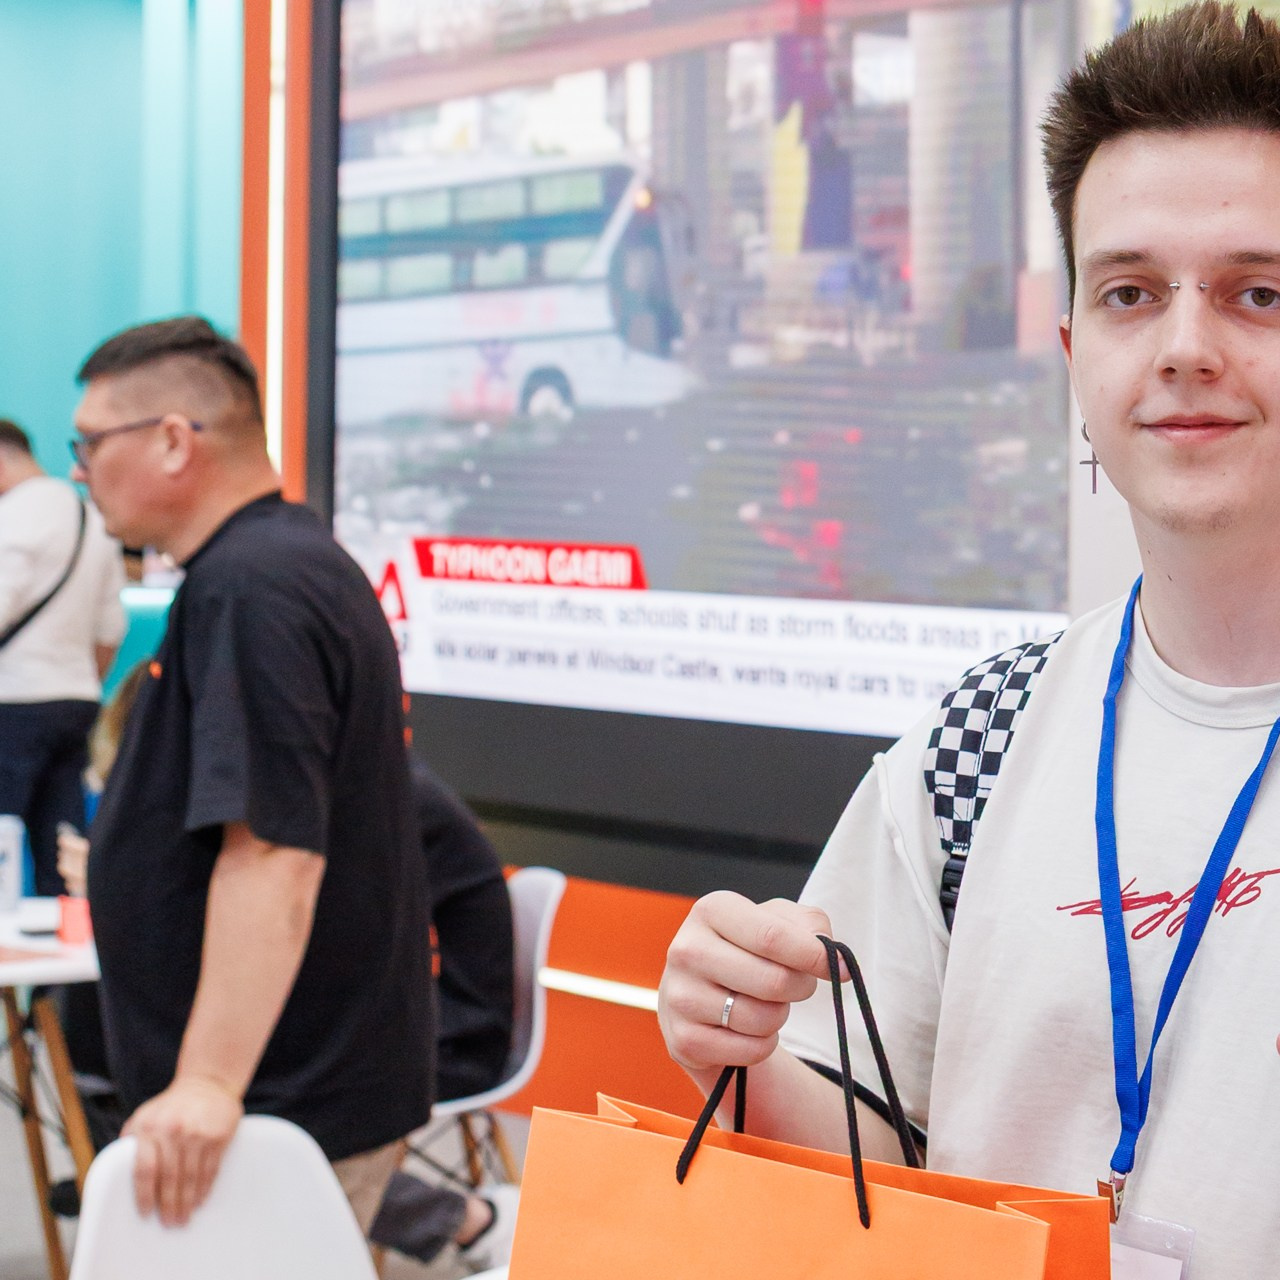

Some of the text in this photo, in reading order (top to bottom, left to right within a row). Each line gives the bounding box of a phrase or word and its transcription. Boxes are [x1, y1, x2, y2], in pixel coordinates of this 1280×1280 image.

[429, 542, 548, 582] TYPHOON
[433, 589, 540, 620] Government
[617, 602, 689, 629] schools
[776, 613, 836, 638] storm
[918, 626, 981, 648] areas
